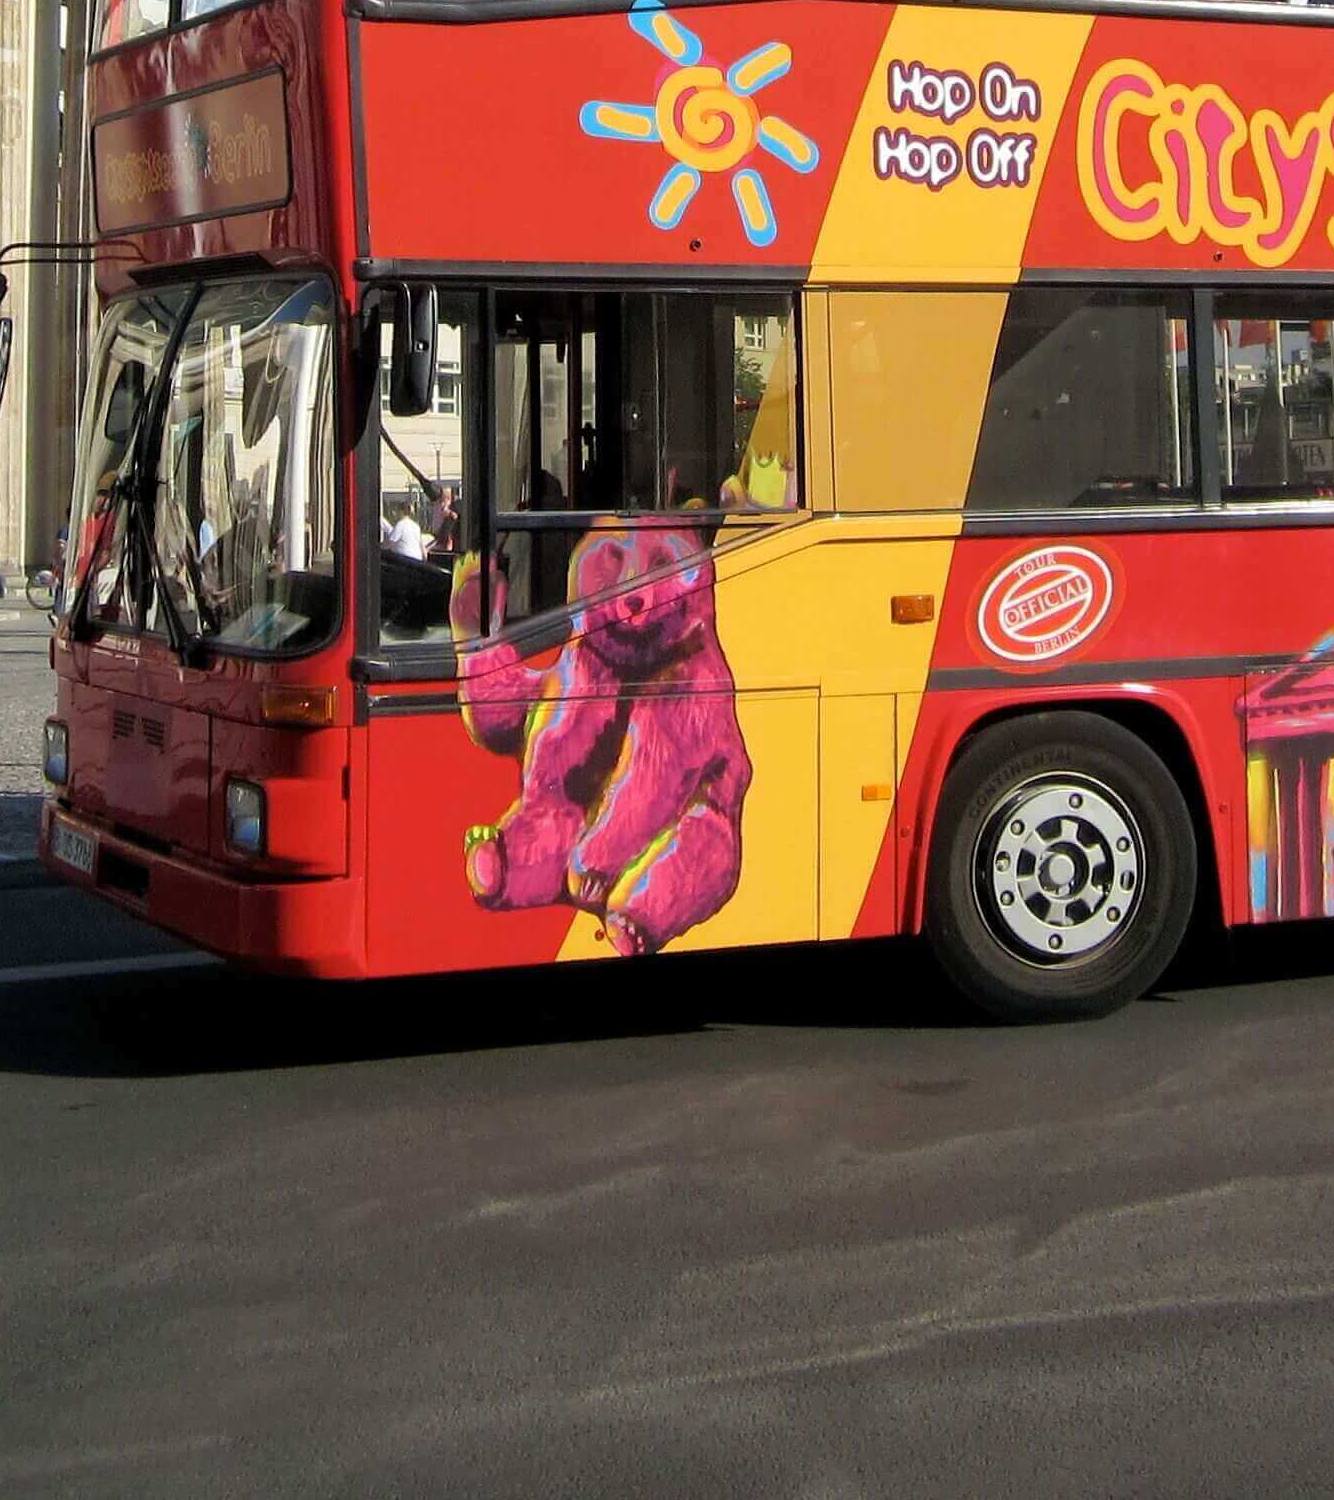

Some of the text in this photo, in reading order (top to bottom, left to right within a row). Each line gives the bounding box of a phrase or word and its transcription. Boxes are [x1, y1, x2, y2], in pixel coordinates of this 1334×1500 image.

[888, 59, 1041, 125] Hop On
[874, 126, 1037, 192] Hop Off
[1014, 553, 1058, 581] TOUR
[1003, 576, 1088, 628] OFFICIAL
[1034, 625, 1081, 654] BERLIN
